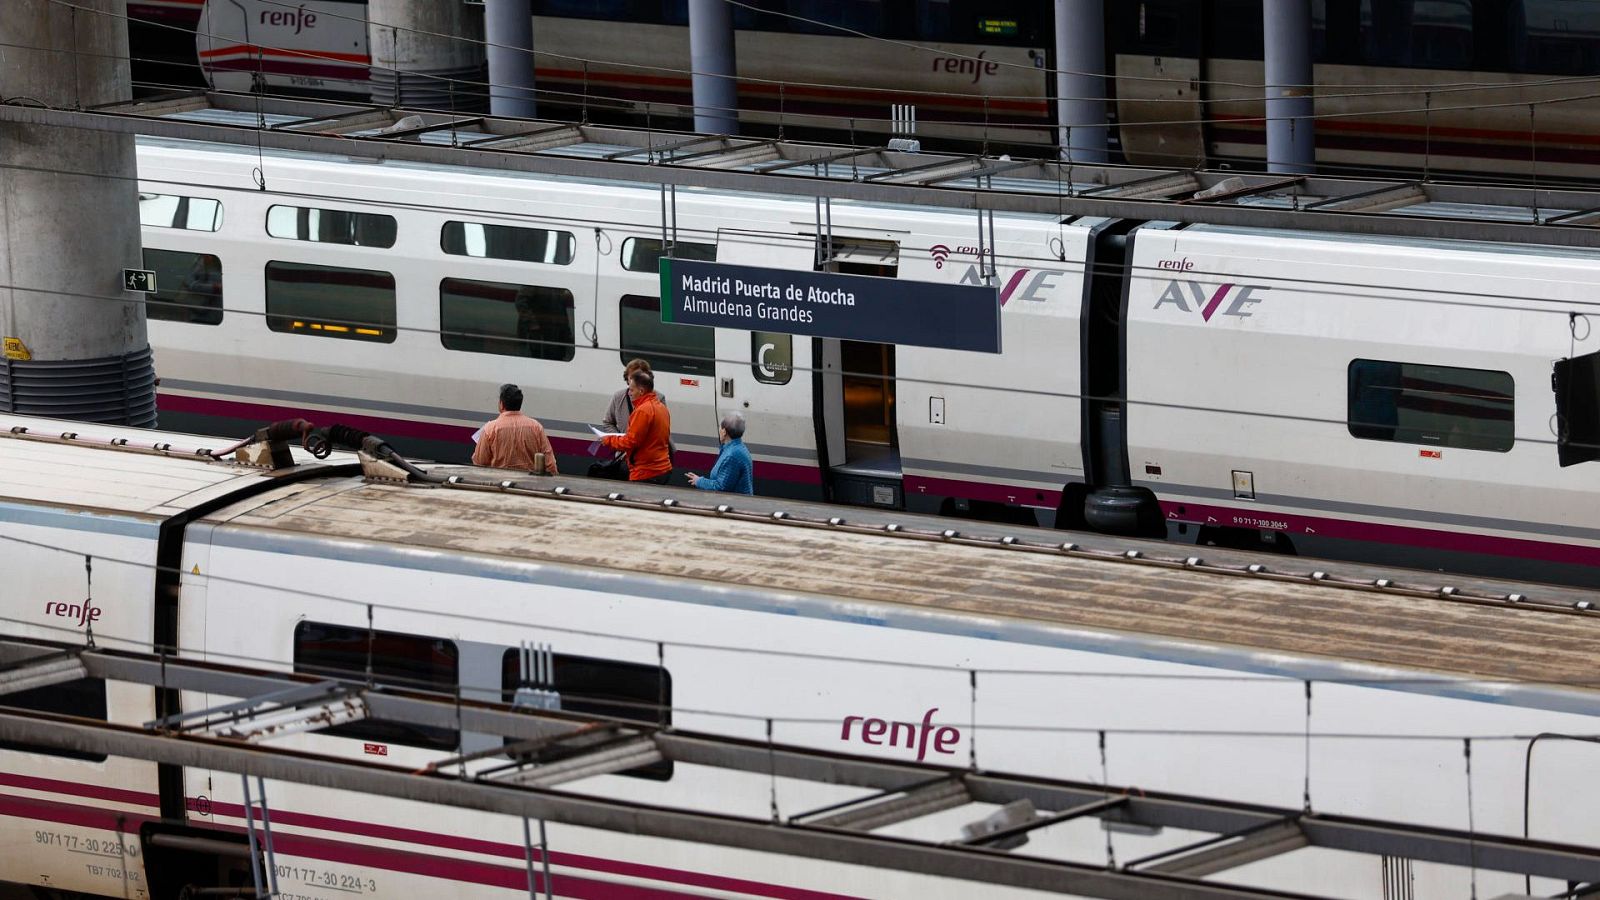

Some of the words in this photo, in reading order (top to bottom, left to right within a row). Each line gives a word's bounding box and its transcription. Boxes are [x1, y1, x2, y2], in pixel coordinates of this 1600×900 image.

[260, 4, 317, 35] renfe
[932, 50, 999, 84] renfe
[957, 244, 990, 260] rene
[1158, 257, 1194, 273] renfe
[682, 274, 731, 295] Madrid
[736, 280, 781, 300] Puerta
[786, 284, 803, 301] de
[808, 286, 855, 306] Atocha
[1152, 279, 1271, 323] AVE
[683, 296, 752, 318] Almudena
[757, 302, 813, 323] Grandes
[45, 598, 102, 627] renfe
[841, 708, 960, 763] renfe
[86, 864, 103, 877] TB7
[105, 867, 121, 879] 702
[340, 874, 376, 892] 224-3
